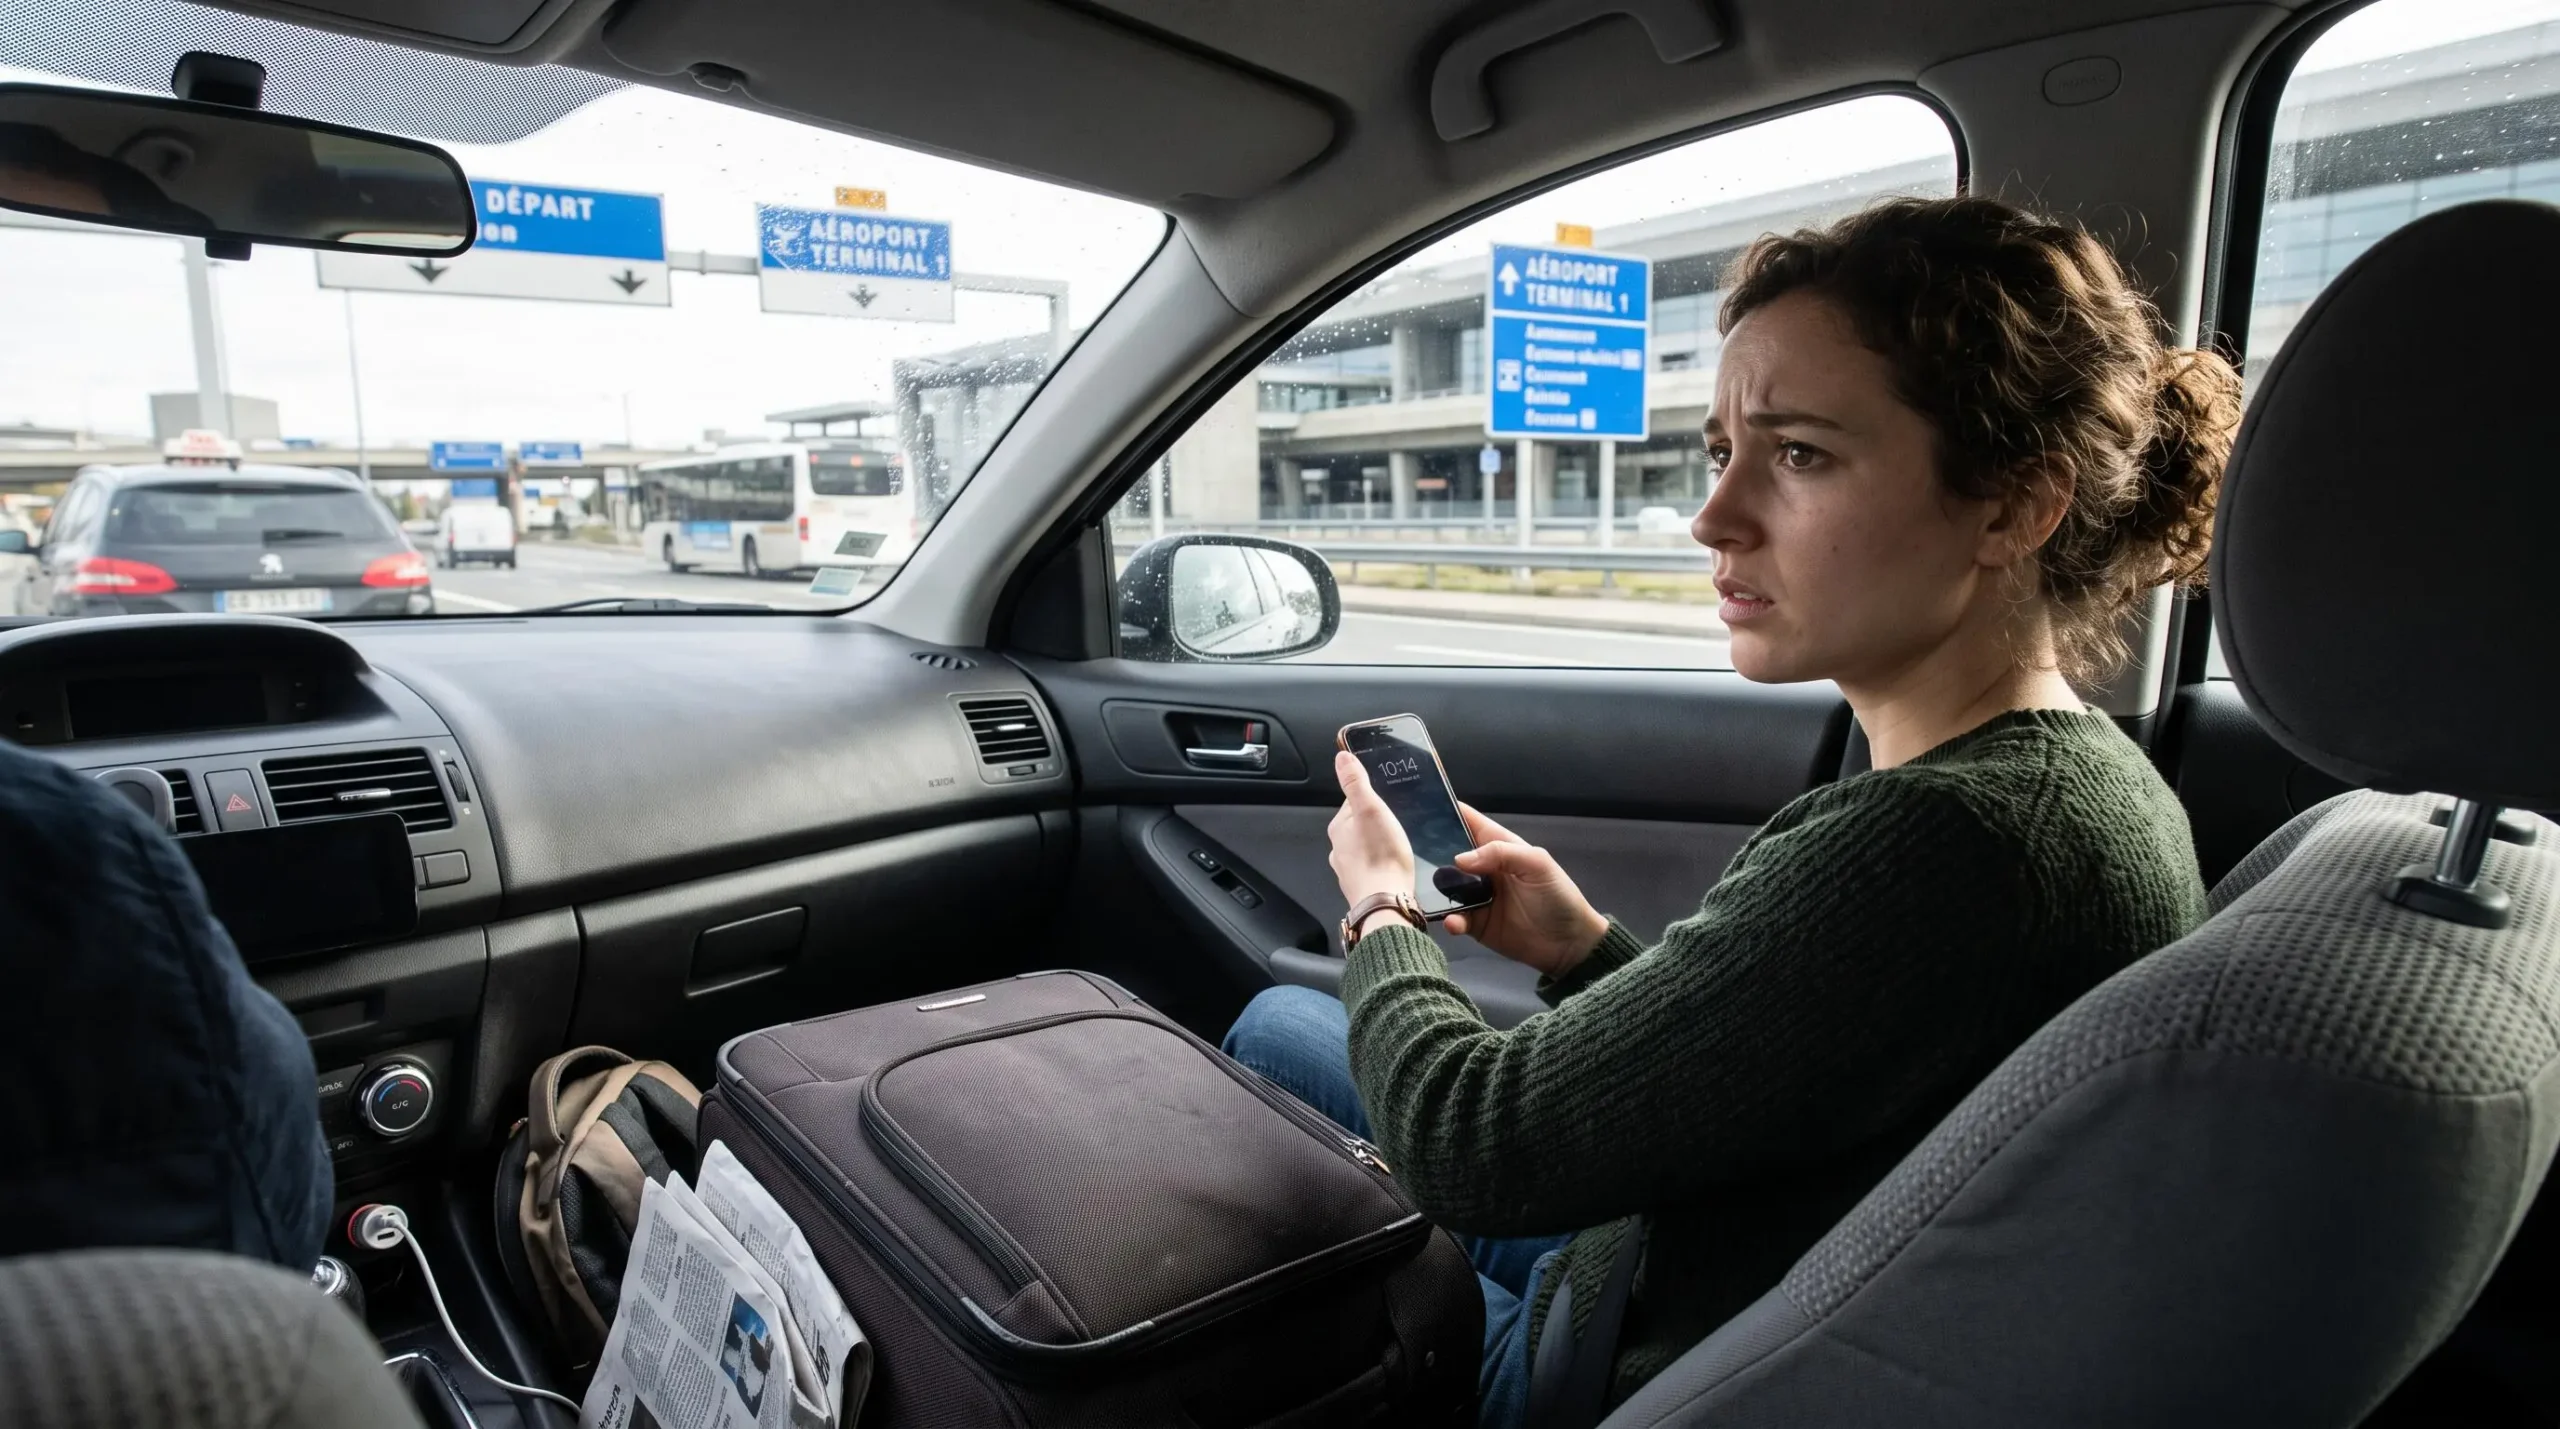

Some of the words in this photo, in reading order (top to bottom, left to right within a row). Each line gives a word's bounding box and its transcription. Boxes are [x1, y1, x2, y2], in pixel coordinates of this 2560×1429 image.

[486, 186, 595, 220] DÉPART
[810, 217, 930, 249] AÉROPORT
[810, 243, 928, 274] TERMINAL
[936, 255, 946, 274] 1
[1525, 253, 1619, 287] AÉROPORT
[1525, 283, 1615, 313] TERMINAL
[1620, 293, 1629, 313] 1
[1378, 757, 1418, 777] 10:14
